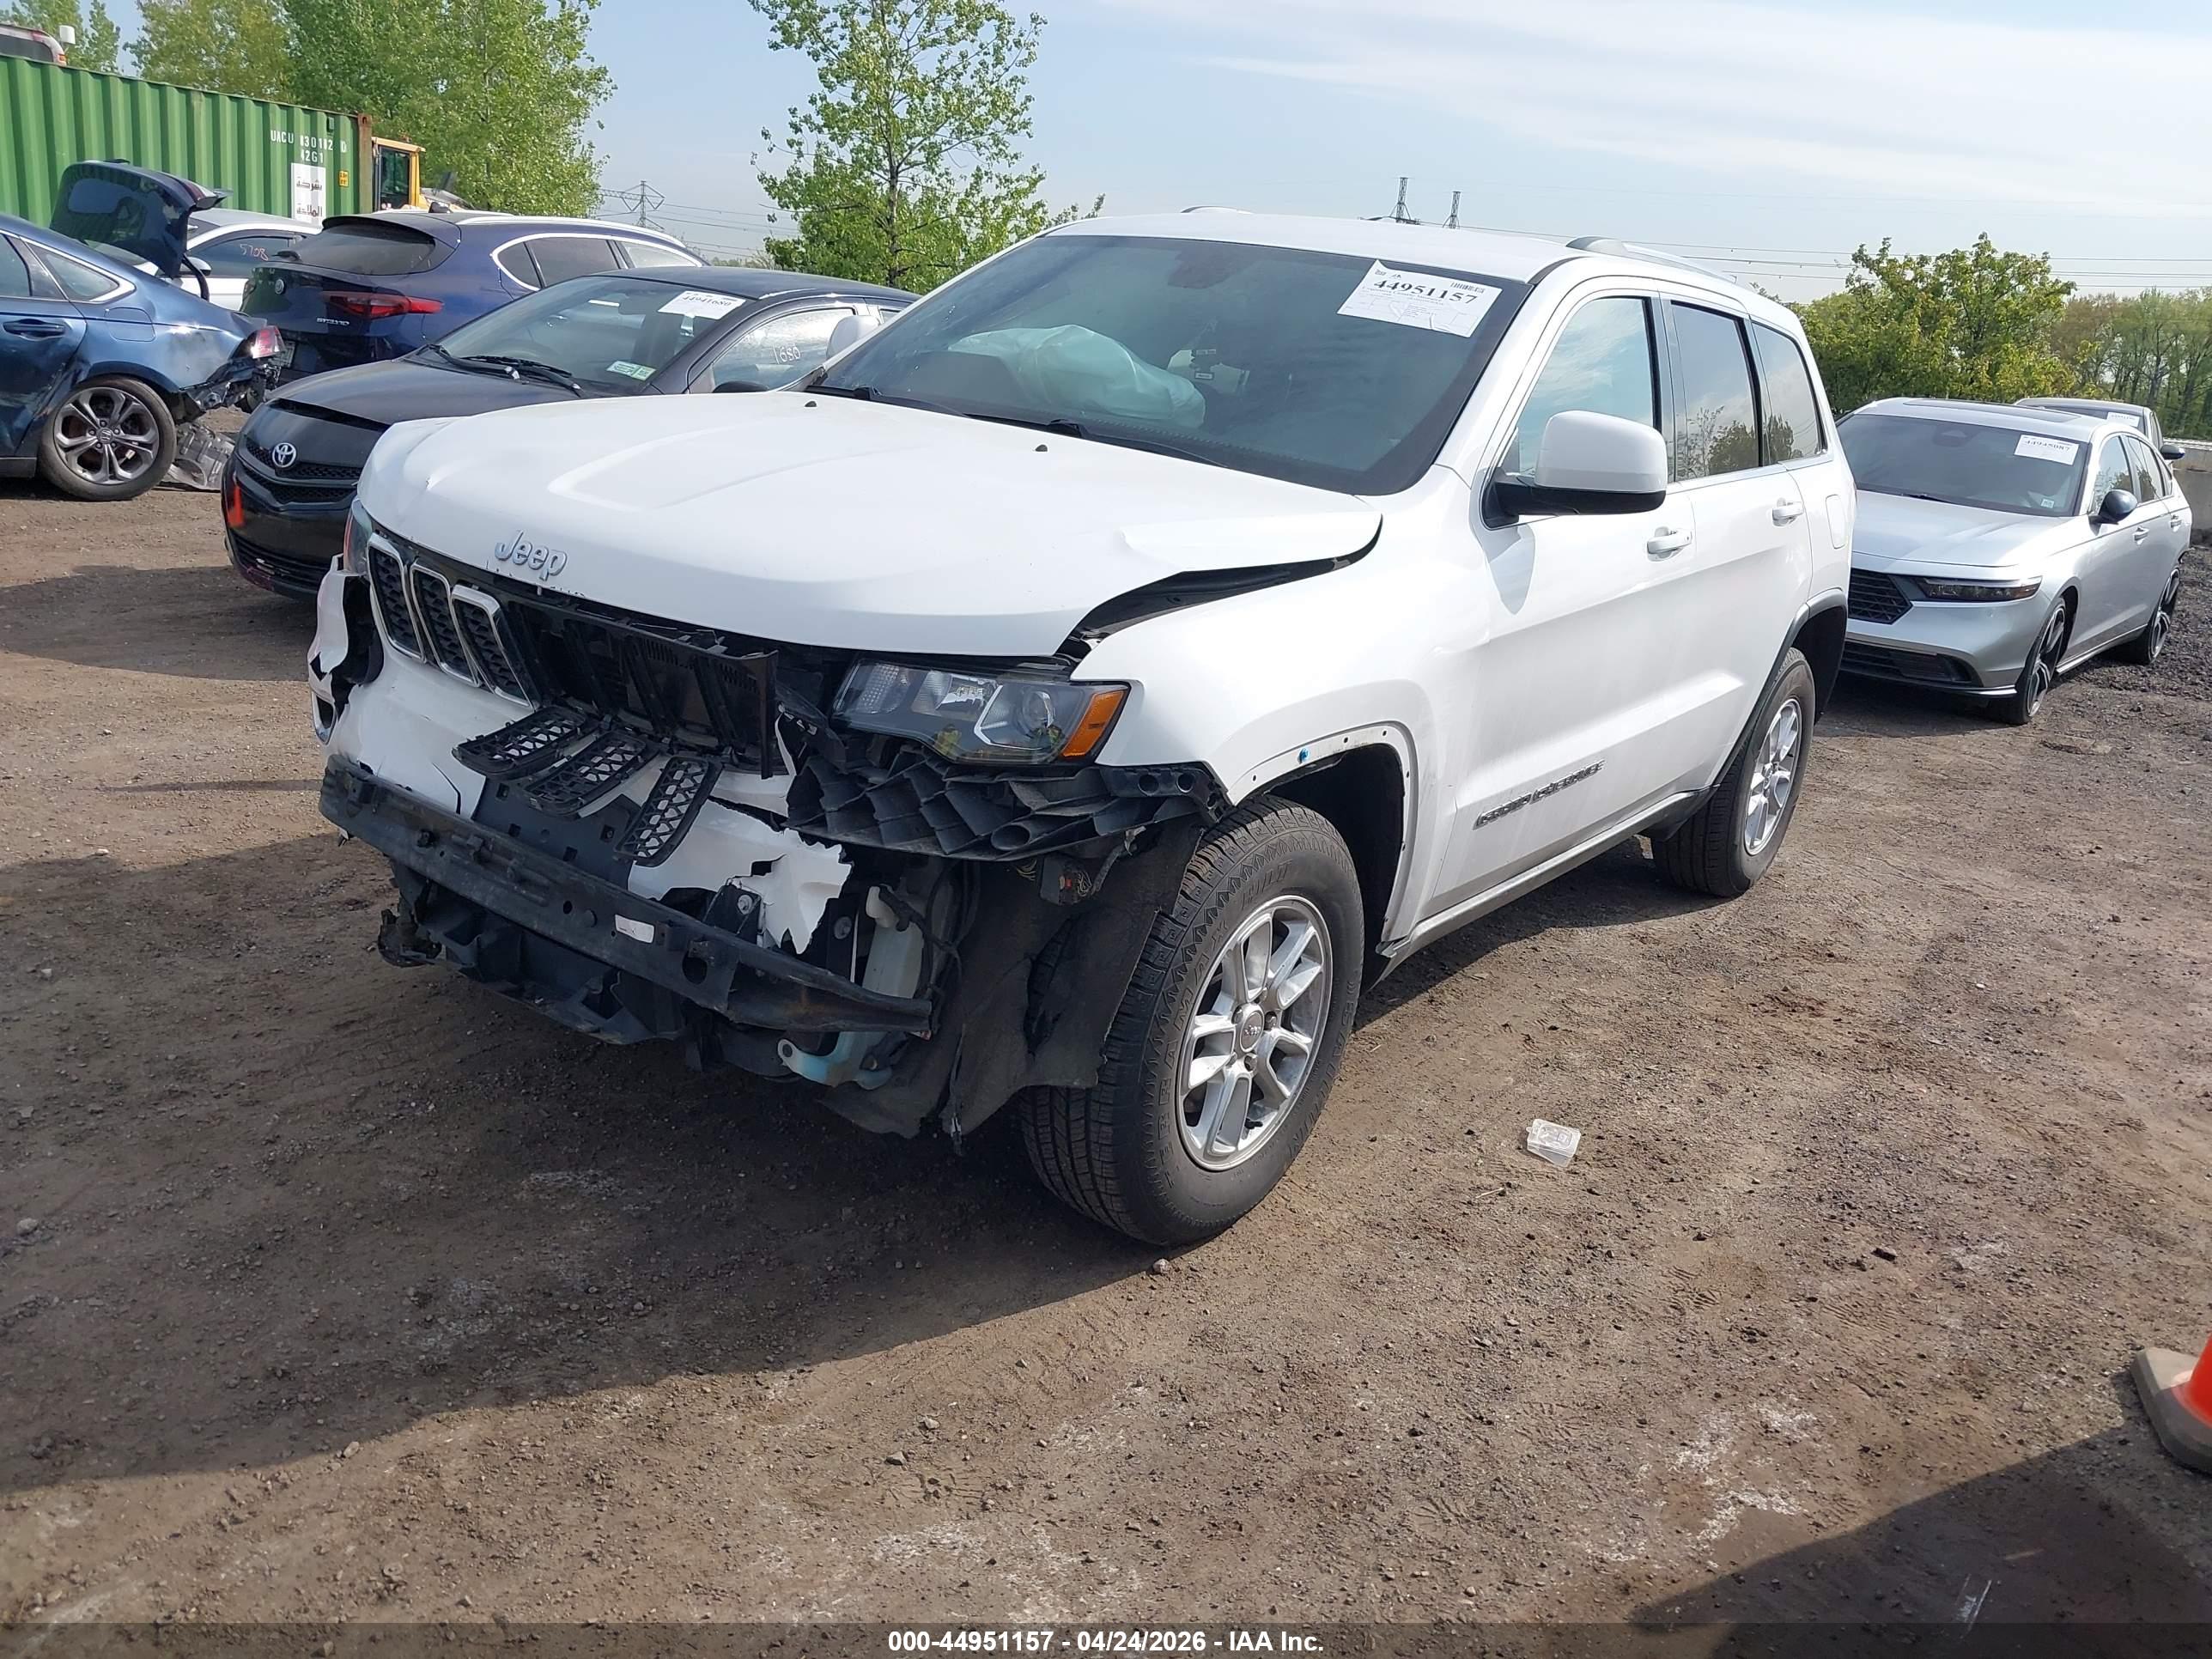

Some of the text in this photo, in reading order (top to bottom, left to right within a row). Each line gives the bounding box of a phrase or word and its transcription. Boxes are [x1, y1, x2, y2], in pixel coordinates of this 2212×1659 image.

[270, 130, 294, 144] UACU
[240, 243, 269, 261] 5708
[1374, 279, 1477, 304] 44951157
[773, 345, 801, 364] 1680
[495, 530, 568, 581] Jeep
